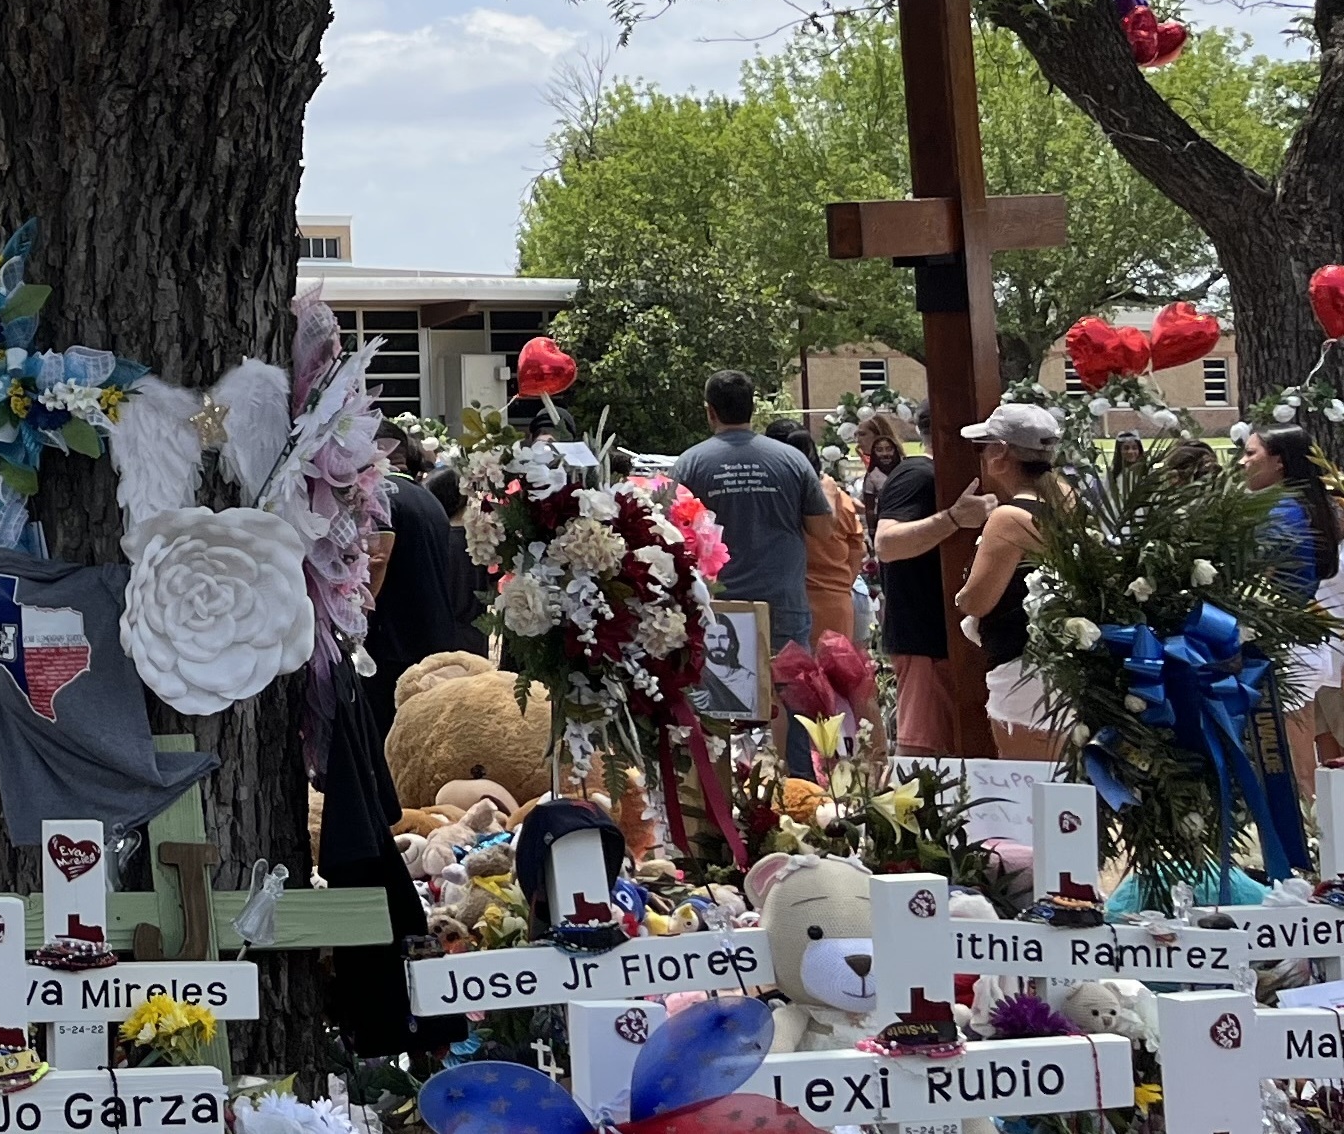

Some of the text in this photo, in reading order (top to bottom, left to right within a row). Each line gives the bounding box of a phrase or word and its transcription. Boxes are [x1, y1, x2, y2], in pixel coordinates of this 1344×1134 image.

[956, 933, 1230, 971] ithia Ramirez
[441, 945, 758, 1004] Jose Jr Flores
[59, 1024, 104, 1035] 5-24-22
[773, 1060, 1064, 1112] Lexi Rubio
[65, 1092, 219, 1128] Garza
